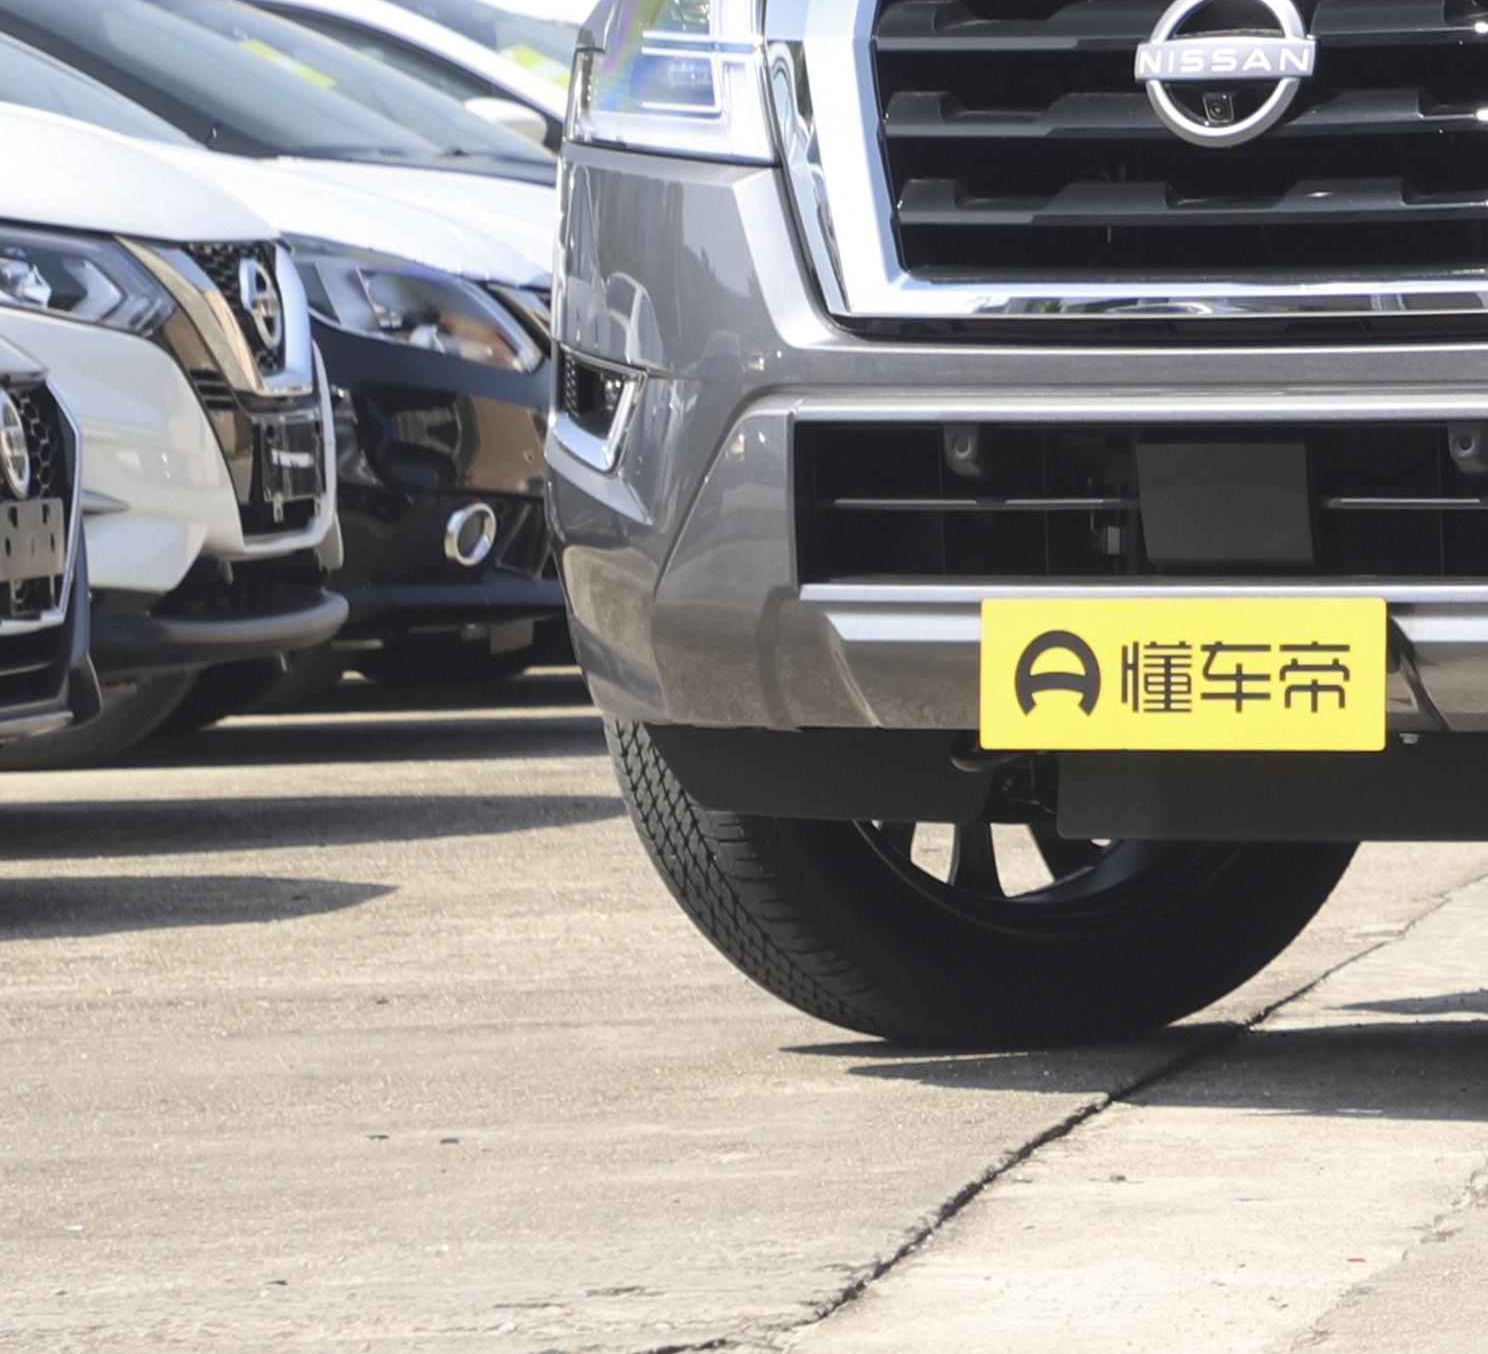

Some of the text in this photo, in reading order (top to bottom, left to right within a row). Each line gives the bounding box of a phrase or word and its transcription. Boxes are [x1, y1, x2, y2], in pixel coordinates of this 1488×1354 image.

[1139, 47, 1310, 75] NISSAN
[1121, 641, 1351, 713] 懂车帝
